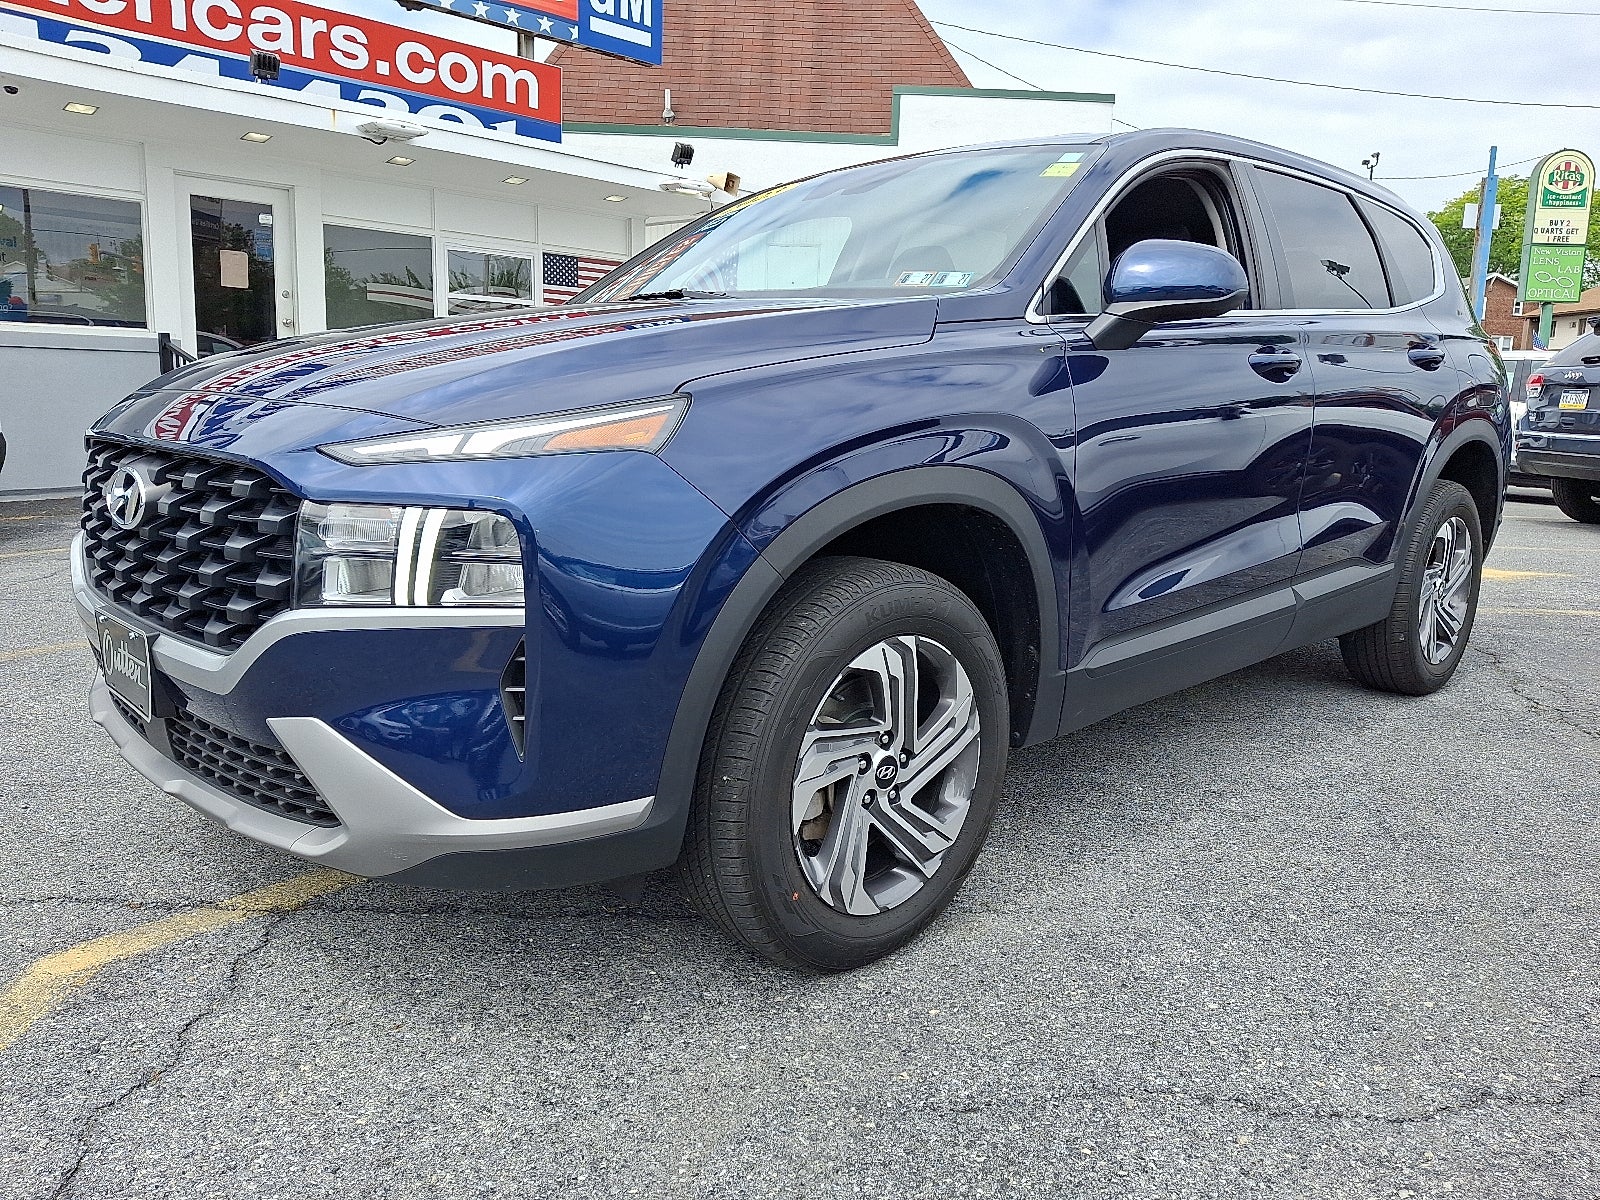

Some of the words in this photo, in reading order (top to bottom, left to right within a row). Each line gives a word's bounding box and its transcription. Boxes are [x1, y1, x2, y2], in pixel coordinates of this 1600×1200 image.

[1553, 170, 1581, 182] Rita's
[1549, 219, 1565, 227] BUY
[1565, 219, 1571, 227] 2
[1565, 227, 1580, 235] GET
[1552, 235, 1571, 243] FREE
[1556, 248, 1582, 256] Vision
[1533, 257, 1560, 266] LENS
[1557, 265, 1581, 274] LAB
[1528, 288, 1577, 299] OPTICAL
